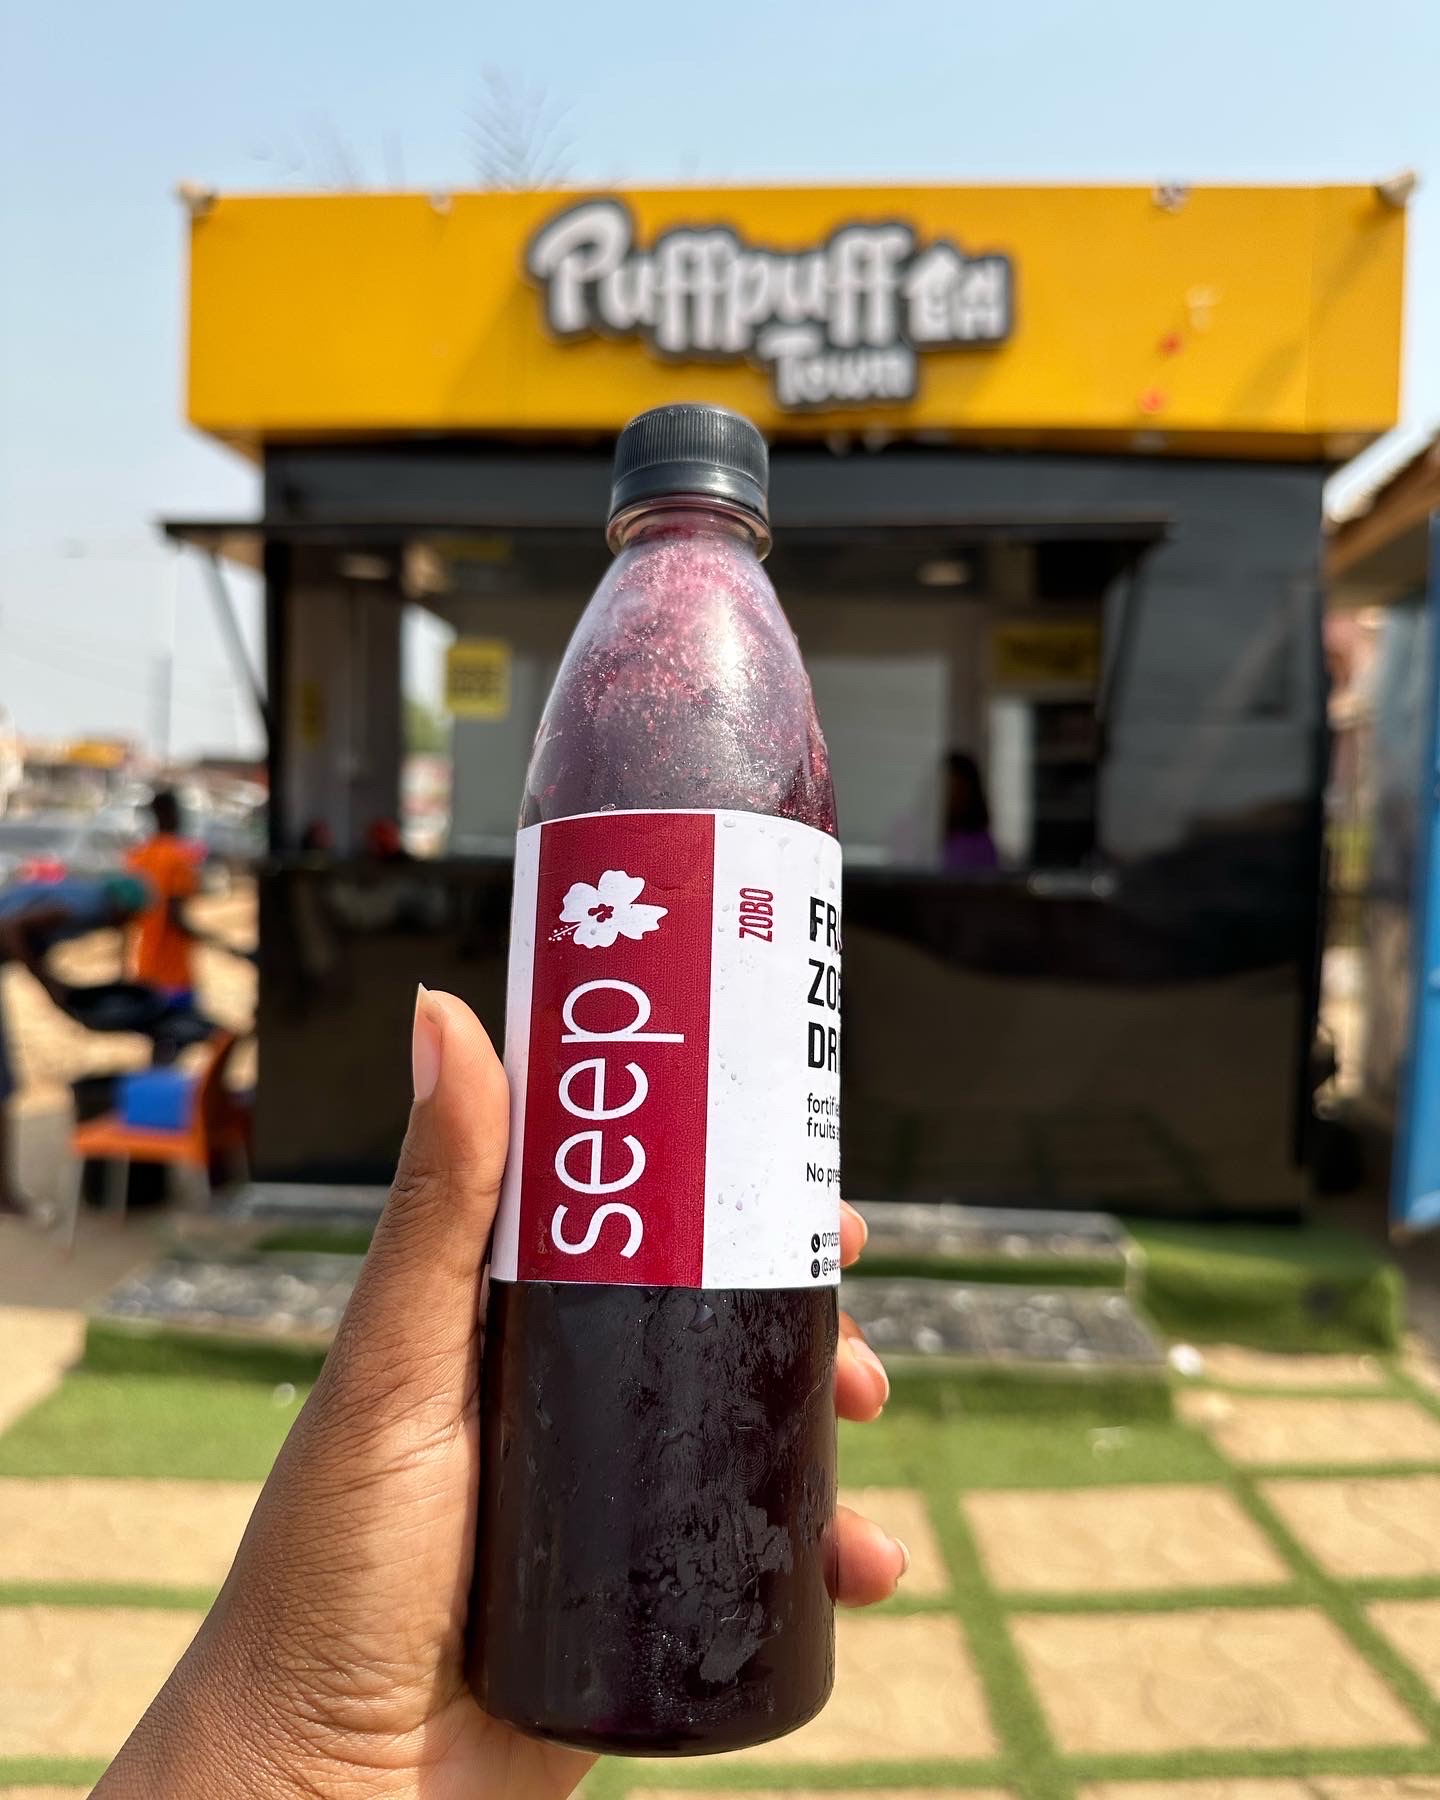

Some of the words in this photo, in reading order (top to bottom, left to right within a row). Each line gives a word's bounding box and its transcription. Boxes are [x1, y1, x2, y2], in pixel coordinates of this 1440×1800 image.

[759, 326, 913, 404] Town
[739, 887, 774, 943] ZOBO
[551, 979, 685, 1259] seep
[806, 1116, 836, 1140] fruits
[806, 1162, 825, 1183] No
